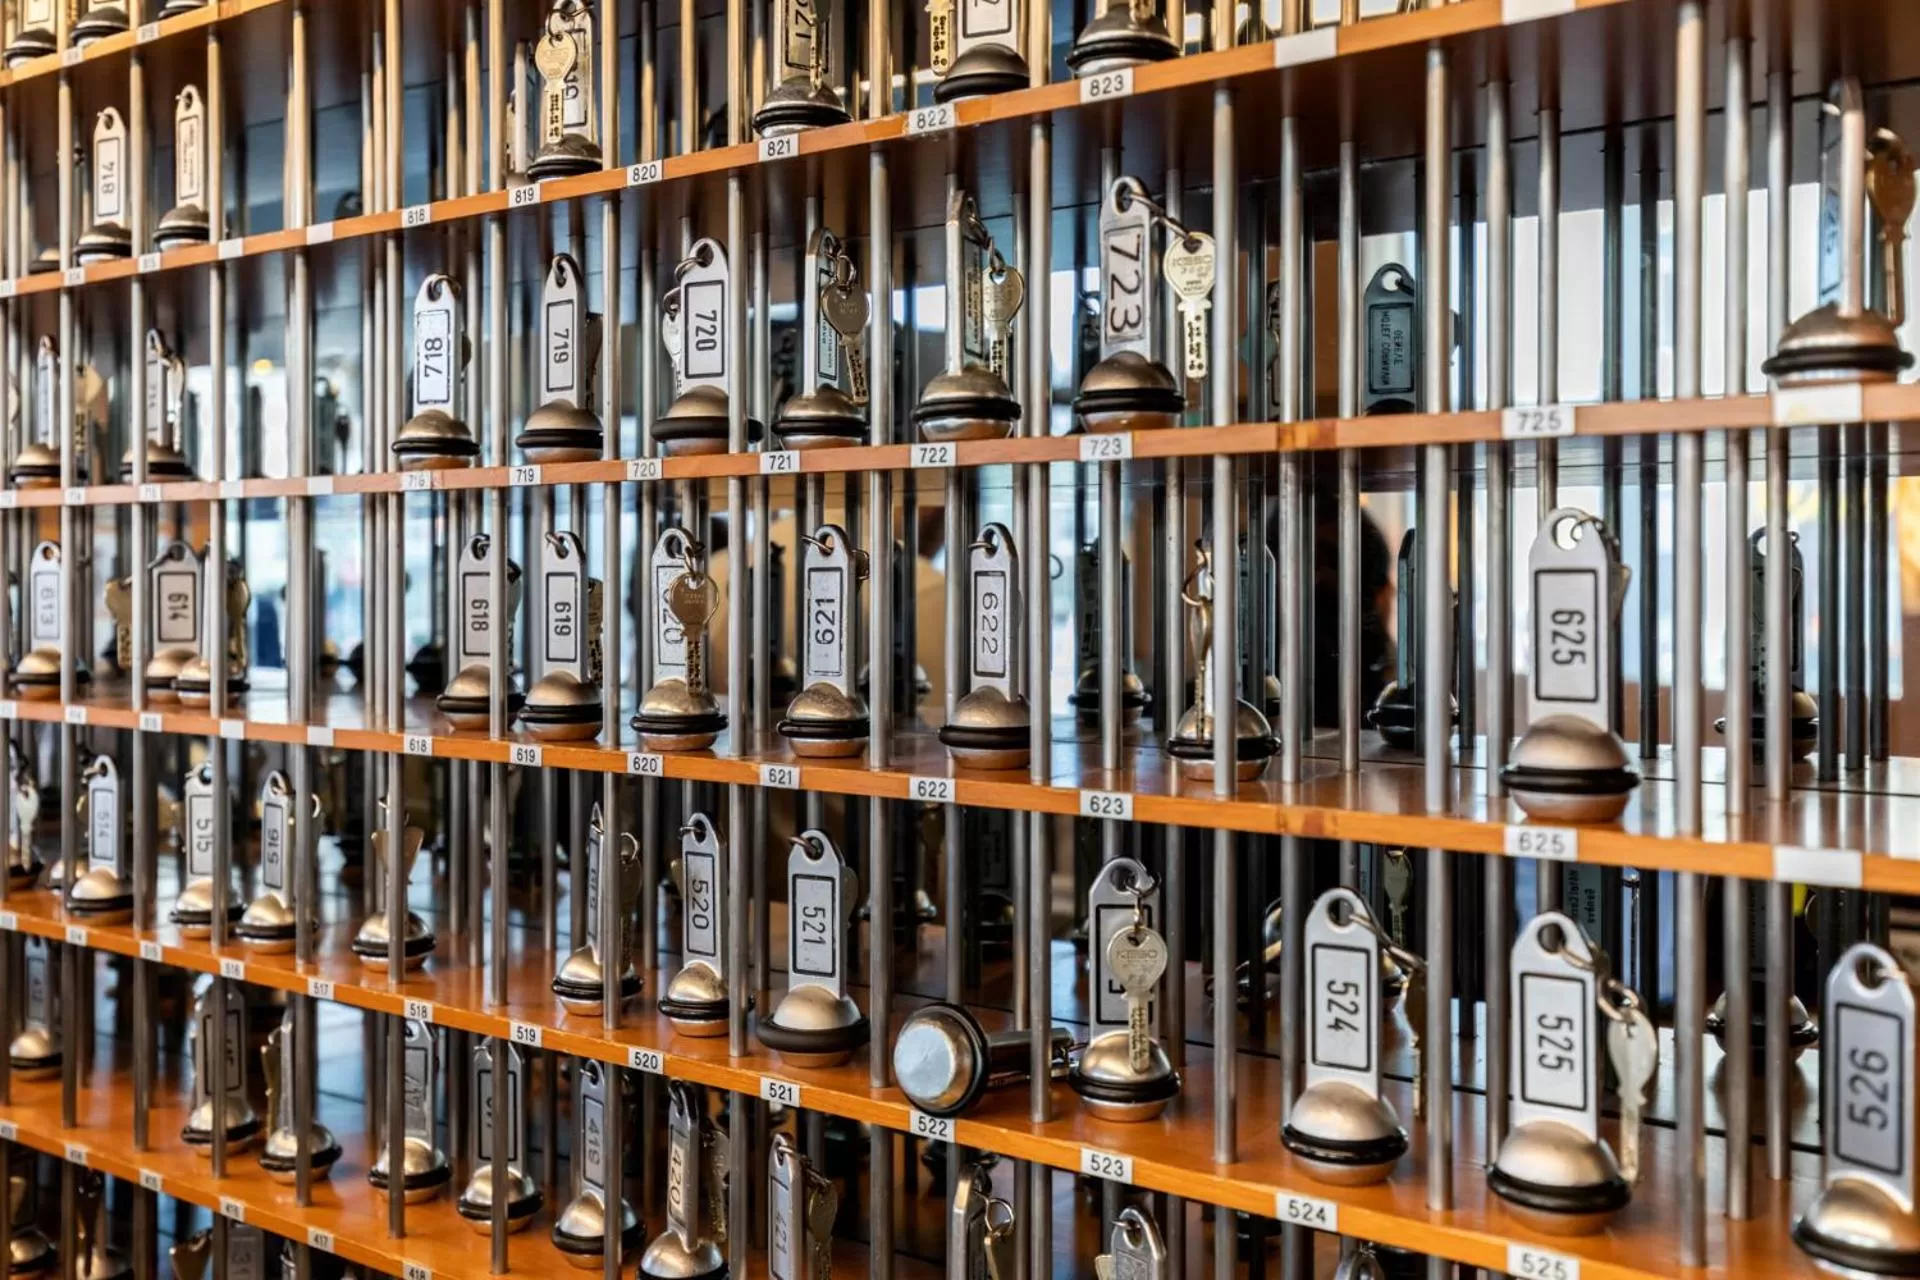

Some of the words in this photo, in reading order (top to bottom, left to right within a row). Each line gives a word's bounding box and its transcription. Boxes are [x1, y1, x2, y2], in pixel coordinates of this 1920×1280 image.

[1090, 74, 1124, 97] 823
[917, 109, 947, 129] 822
[767, 140, 791, 156] 821
[102, 161, 115, 195] 814
[632, 167, 657, 182] 820
[515, 190, 534, 203] 819
[1110, 234, 1141, 332] 723
[695, 310, 717, 352] 720
[424, 337, 443, 377] 718
[554, 328, 569, 364] 719
[1517, 411, 1562, 433] 725
[920, 447, 947, 463] 722
[1090, 437, 1122, 456] 723
[634, 463, 656, 477] 720
[769, 455, 792, 470] 721
[516, 468, 534, 483] 719
[168, 592, 188, 620] 614
[471, 599, 490, 631] 618
[554, 601, 571, 636] 619
[815, 598, 835, 644] 621
[982, 591, 998, 655] 622
[1552, 609, 1586, 665] 625
[409, 738, 427, 752] 618
[517, 748, 535, 763] 619
[633, 757, 657, 773] 620
[769, 768, 792, 786] 621
[918, 781, 948, 798] 622
[1090, 797, 1124, 815] 623
[196, 819, 212, 853] 515
[267, 828, 280, 863] 516
[1518, 833, 1565, 855] 625
[692, 879, 709, 930] 520
[802, 906, 826, 947] 521
[313, 982, 329, 996] 517
[410, 1003, 427, 1019] 518
[1327, 980, 1359, 1034] 524
[516, 1025, 536, 1042] 519
[1537, 1013, 1574, 1073] 525
[634, 1052, 659, 1070] 520
[769, 1083, 793, 1101] 521
[1848, 1047, 1889, 1131] 526
[918, 1119, 948, 1137] 522
[1091, 1155, 1124, 1178] 523
[670, 1150, 682, 1206] 420
[1287, 1199, 1327, 1223] 524
[314, 1234, 329, 1248] 417
[1521, 1253, 1567, 1280] 525
